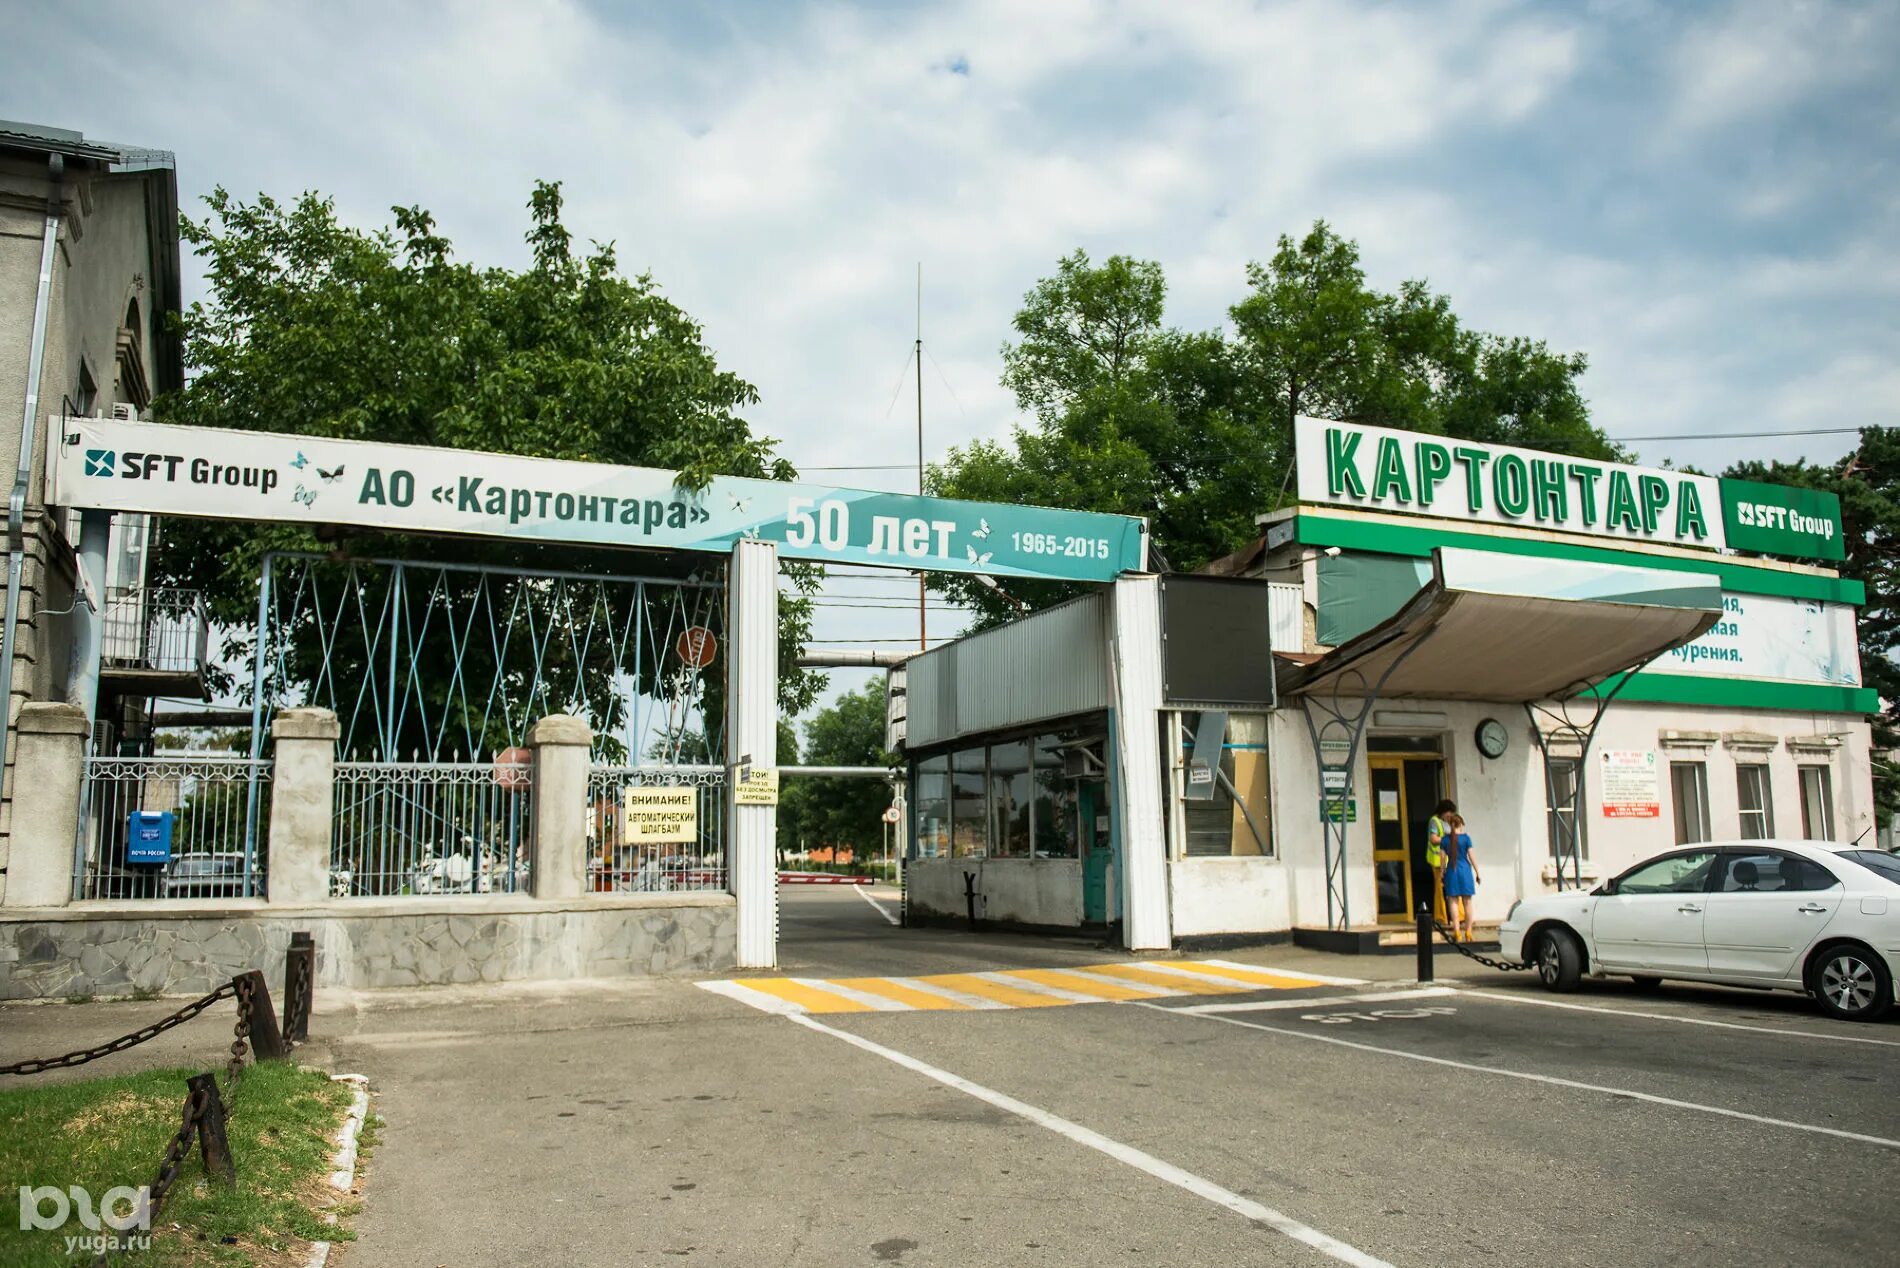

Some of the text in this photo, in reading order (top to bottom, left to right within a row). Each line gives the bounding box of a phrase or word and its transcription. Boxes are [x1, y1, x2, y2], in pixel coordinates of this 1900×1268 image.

[121, 452, 278, 494] SFT Group
[1325, 427, 1709, 540] КАРТОНТАРА
[358, 468, 711, 535] АО «Картонтара»
[786, 498, 956, 560] 50 лет
[1754, 504, 1834, 540] SFT Group
[1011, 532, 1110, 560] 1965-2015
[628, 812, 695, 822] АВТОМАТИЧЕСКИЙ
[631, 795, 691, 805] ВНИМАНИЕ!
[641, 824, 681, 834] ШЛАГБАУМ
